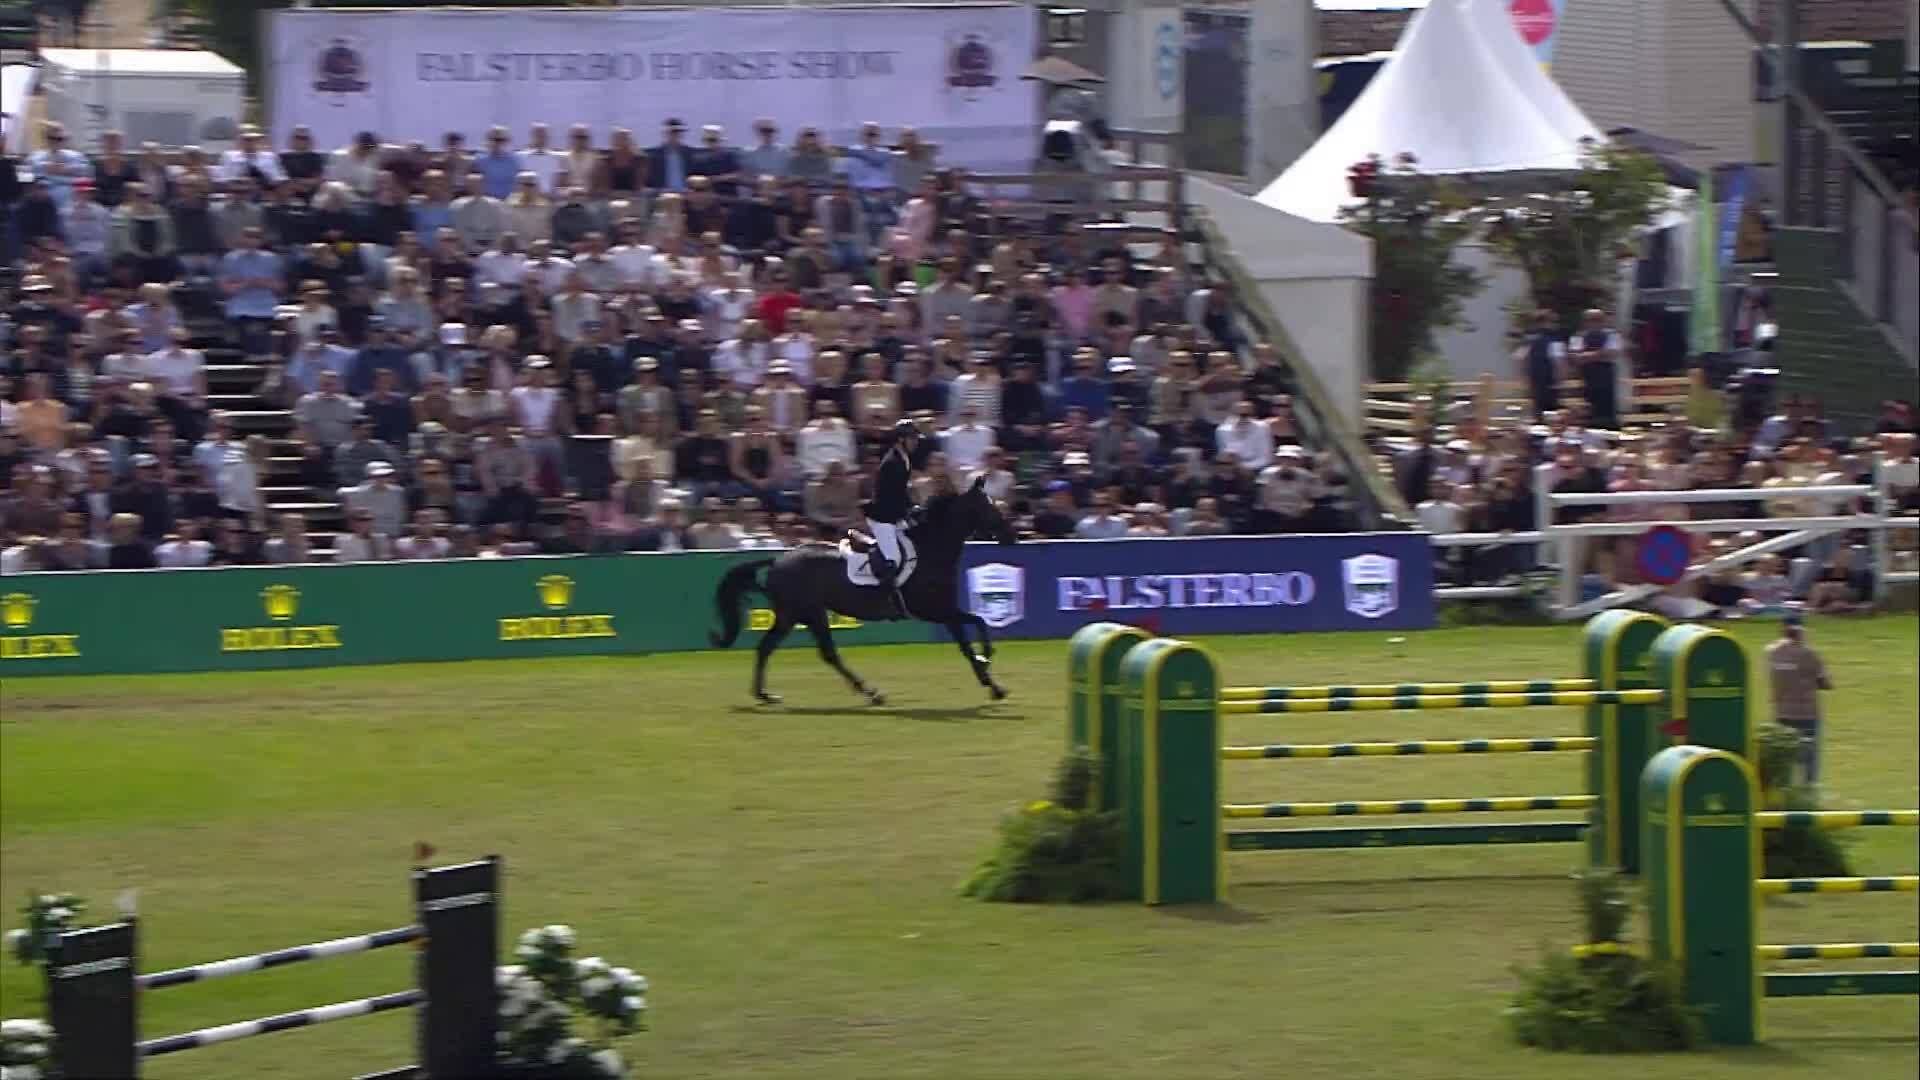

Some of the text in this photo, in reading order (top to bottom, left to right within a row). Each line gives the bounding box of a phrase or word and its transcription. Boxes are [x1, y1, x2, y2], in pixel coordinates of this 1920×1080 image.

[416, 50, 900, 82] FALSTERBO HORSE SHOW
[1056, 571, 1316, 610] FALSTERBO
[220, 625, 343, 651] ROLEX
[498, 614, 617, 640] ROLEX
